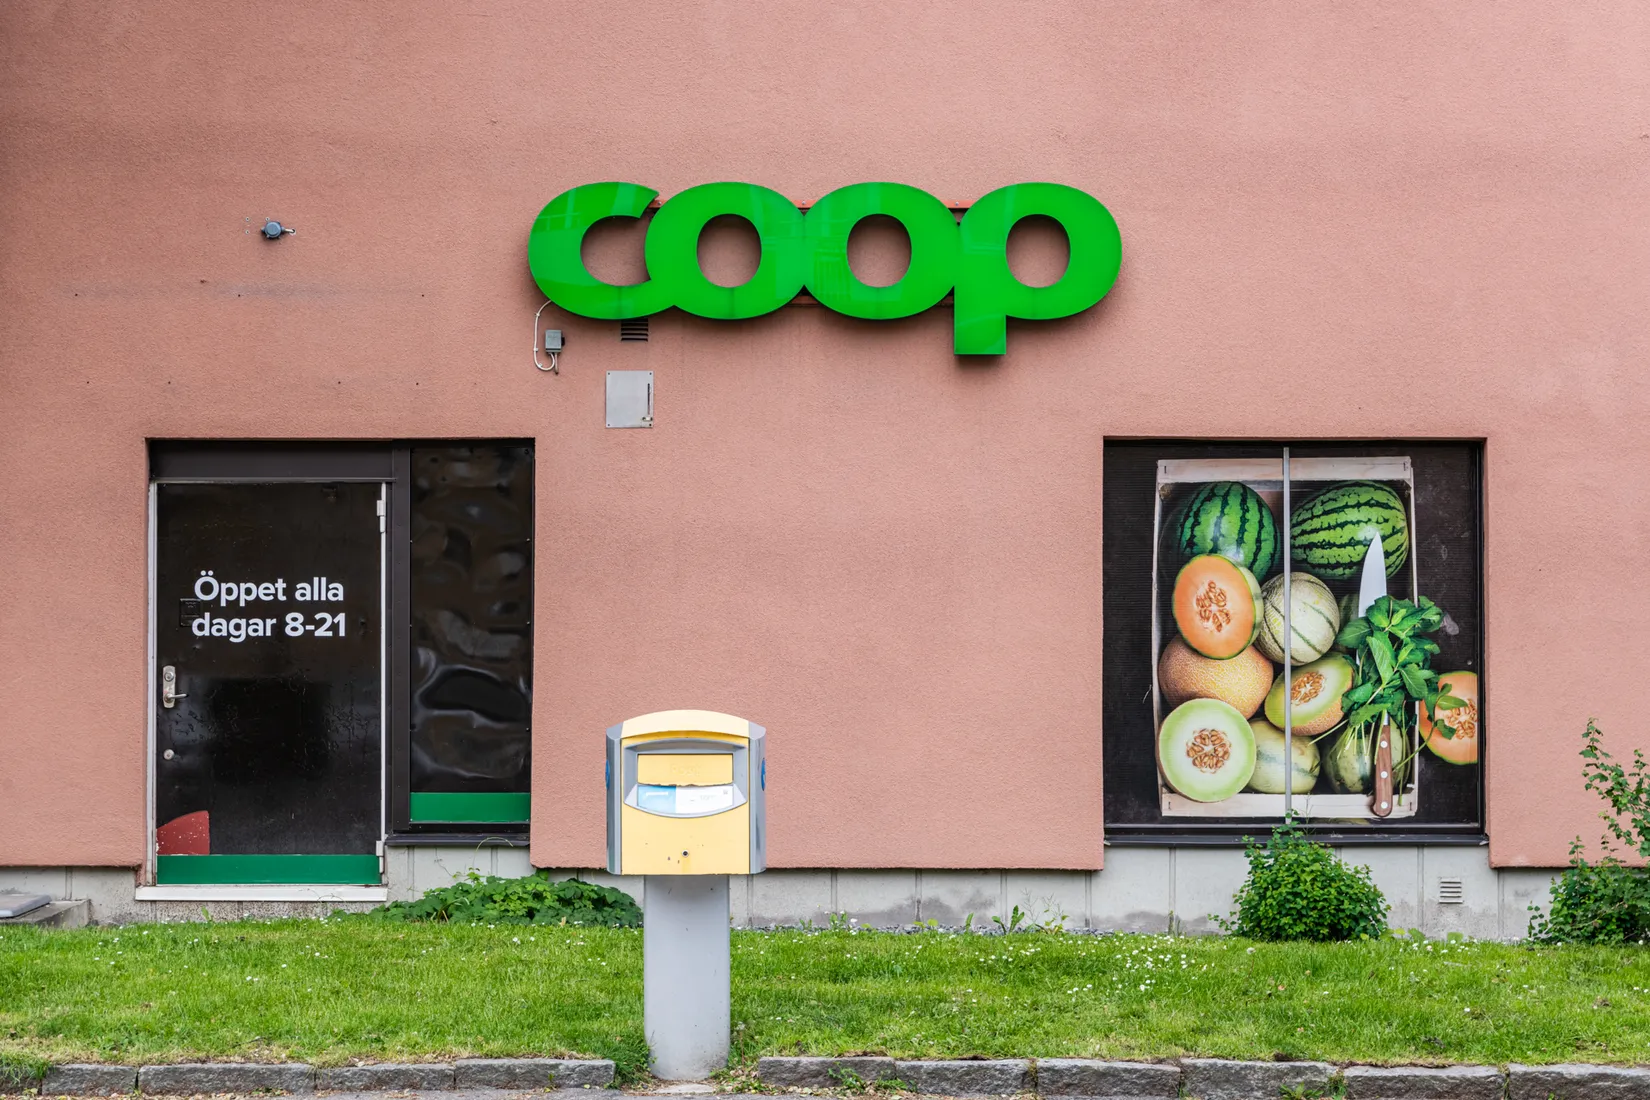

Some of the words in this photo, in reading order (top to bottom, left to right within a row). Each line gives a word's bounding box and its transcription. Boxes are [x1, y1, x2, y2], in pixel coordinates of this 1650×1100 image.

[528, 181, 1122, 357] coop
[194, 570, 287, 607] Öppet
[294, 576, 344, 601] alla
[191, 612, 277, 643] dagar
[285, 612, 346, 637] 8-21
